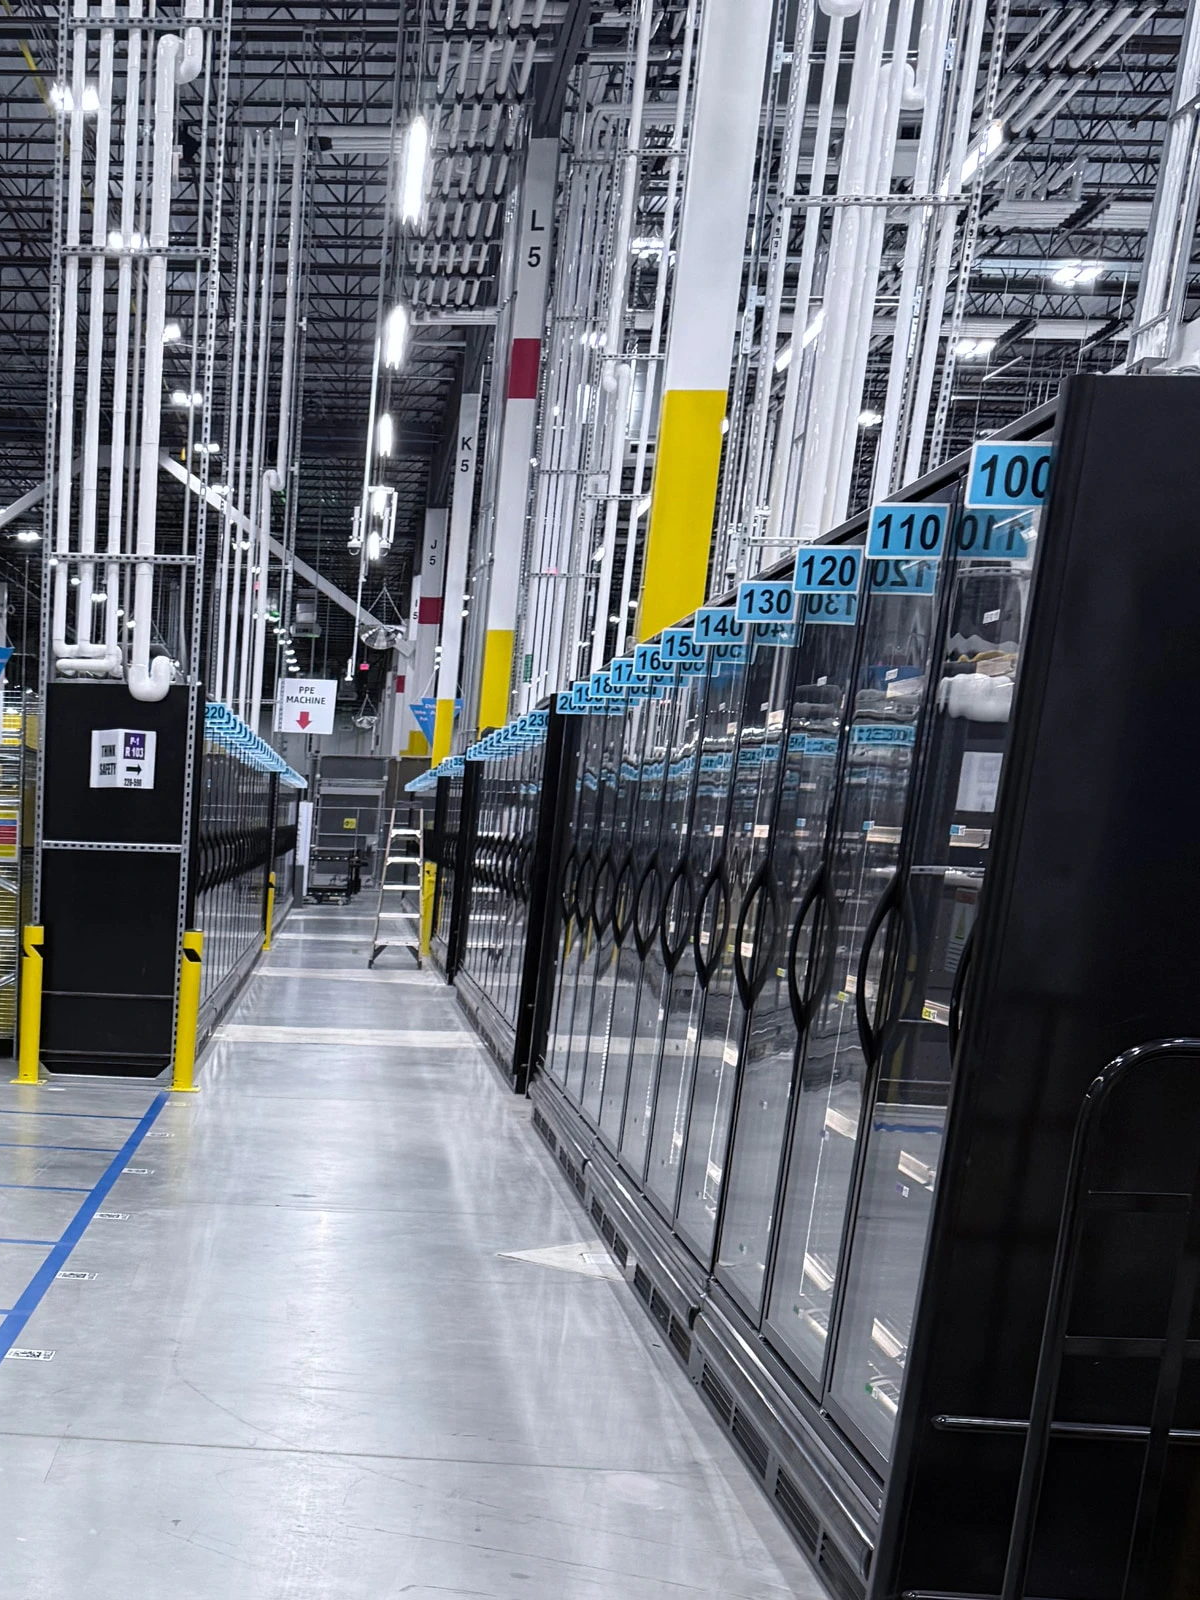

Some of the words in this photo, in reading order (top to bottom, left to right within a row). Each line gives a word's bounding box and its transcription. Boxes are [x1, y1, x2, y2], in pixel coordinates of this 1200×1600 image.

[531, 209, 545, 231] L
[527, 246, 541, 268] 5
[461, 437, 472, 451] K
[460, 459, 469, 473] 5
[877, 513, 941, 550] 110
[430, 539, 438, 550] J
[429, 555, 436, 566] 5
[801, 555, 856, 586] 120
[743, 588, 792, 614] 130
[299, 686, 315, 694] PPE
[286, 696, 326, 705] MACHINE
[124, 746, 131, 757] R
